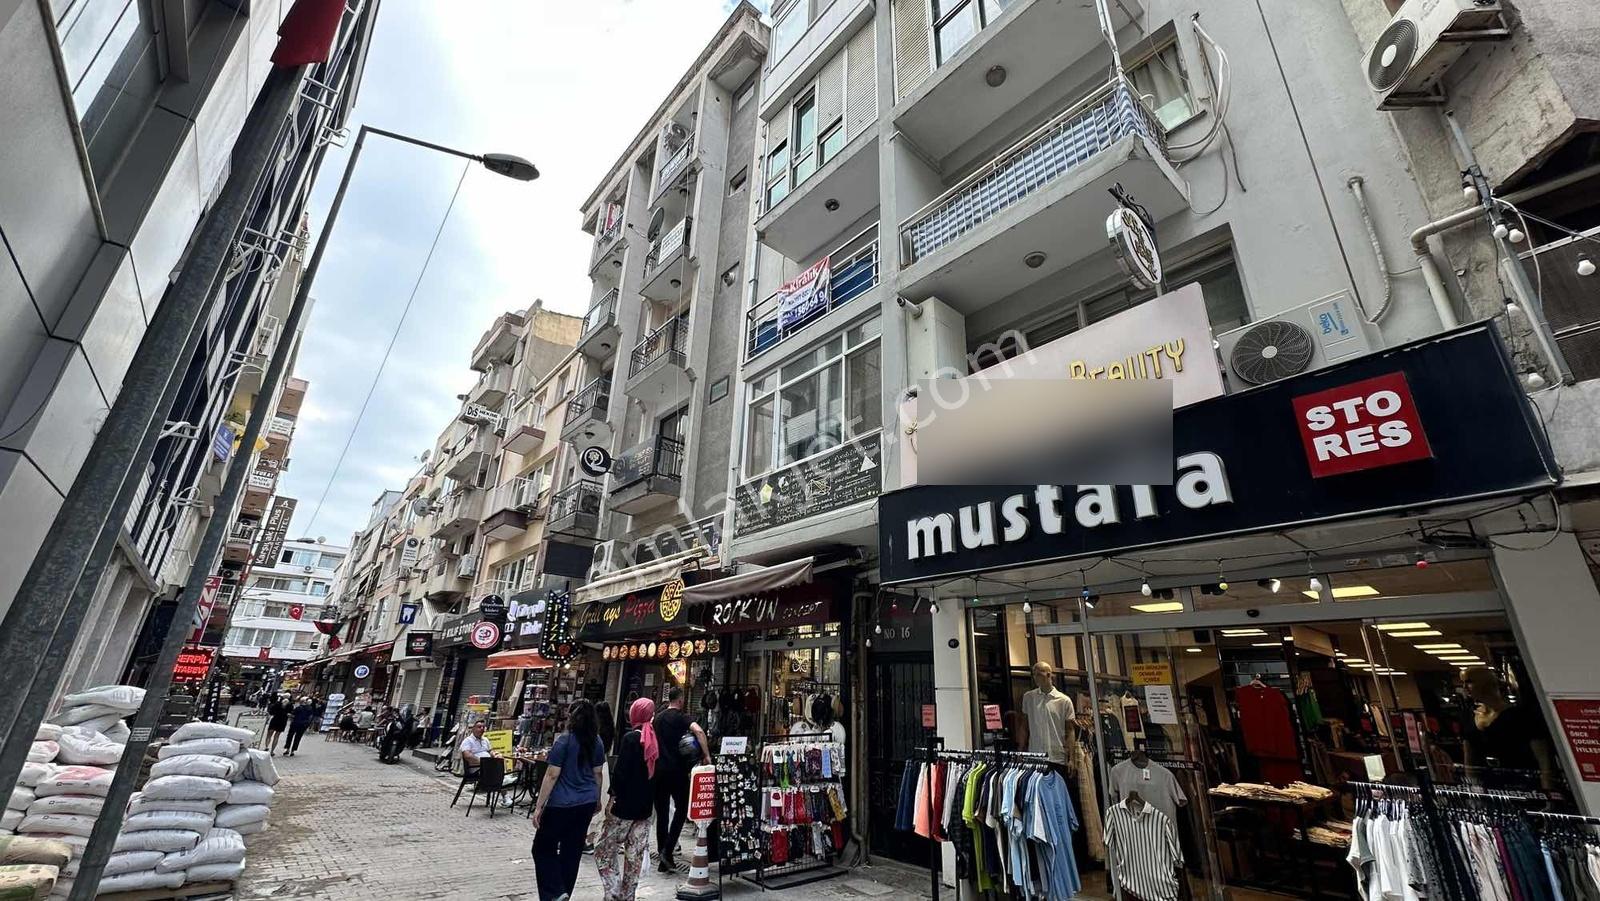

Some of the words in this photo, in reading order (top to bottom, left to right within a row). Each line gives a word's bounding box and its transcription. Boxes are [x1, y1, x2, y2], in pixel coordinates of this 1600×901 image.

[1305, 390, 1402, 432] STO
[1312, 420, 1412, 462] RES
[270, 509, 282, 527] Plus
[624, 594, 657, 624] Pizza
[712, 598, 779, 625] ROCK'UN
[884, 628, 896, 640] NO
[900, 625, 911, 639] 16
[173, 664, 209, 675] İTABEVİ
